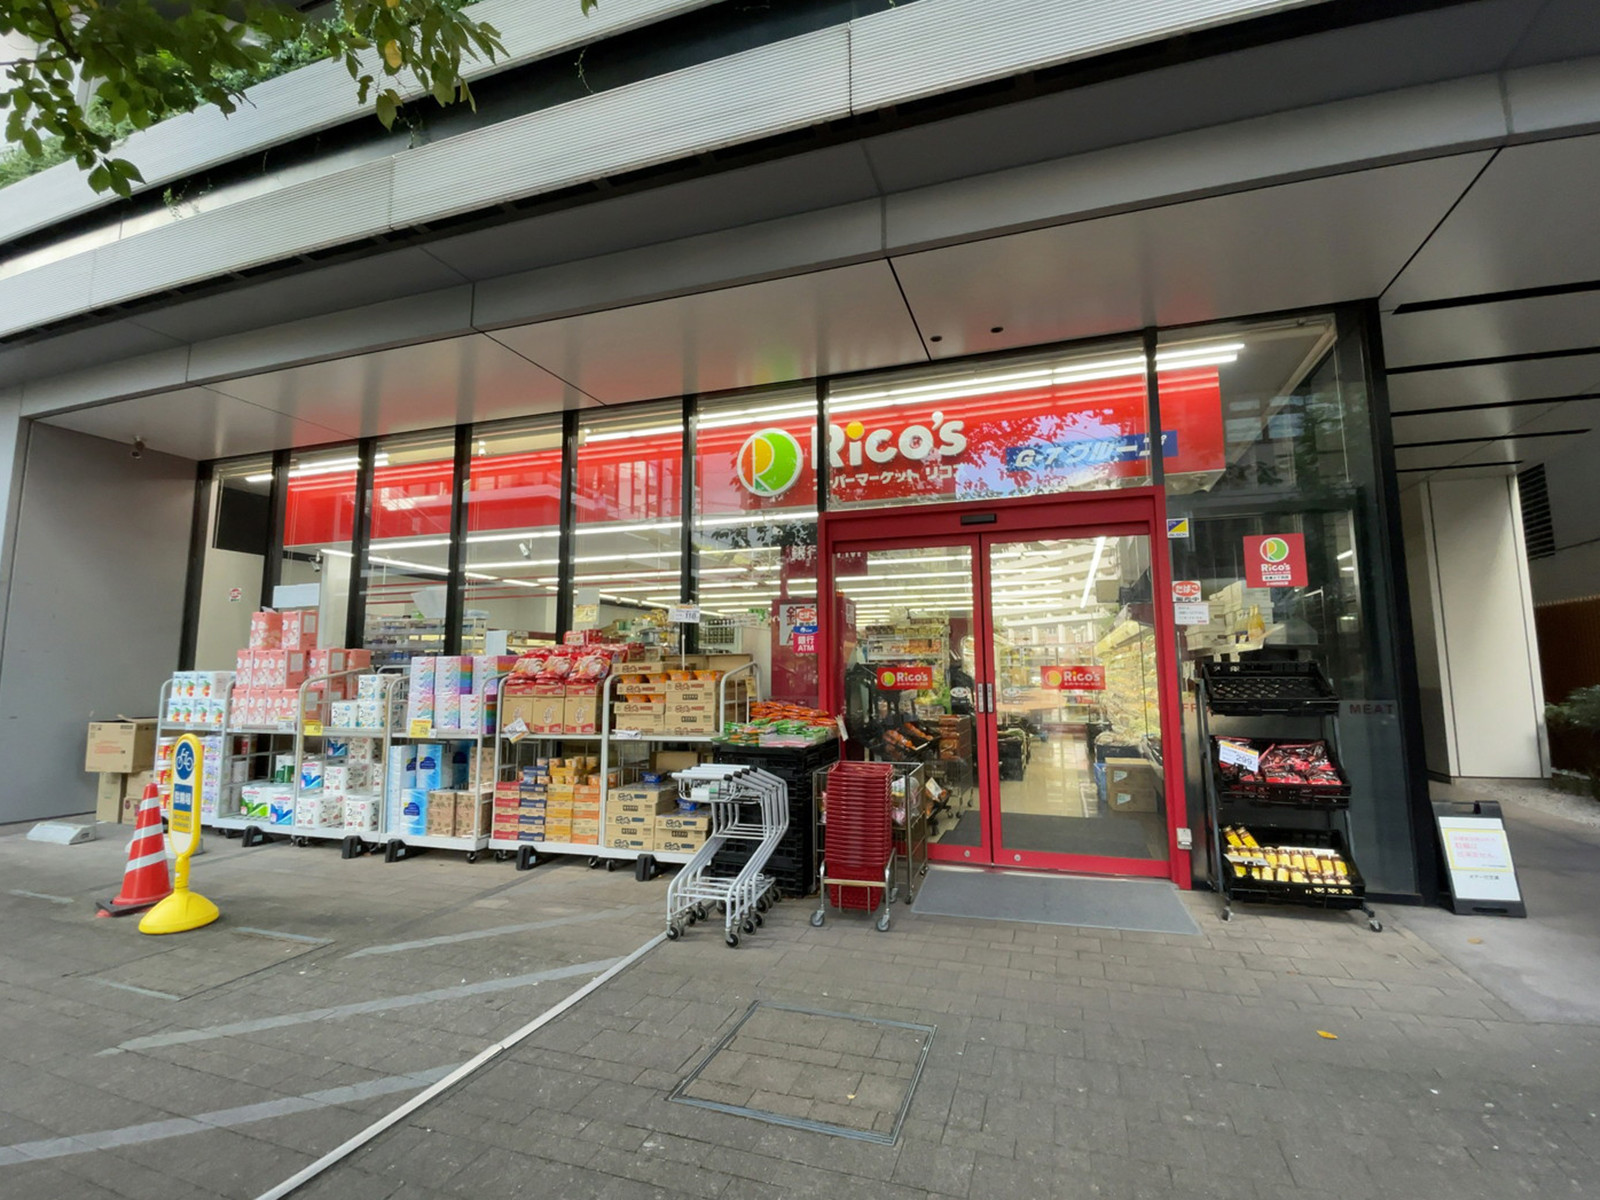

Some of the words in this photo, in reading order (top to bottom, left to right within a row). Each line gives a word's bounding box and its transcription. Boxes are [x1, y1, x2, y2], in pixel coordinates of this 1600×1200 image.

[811, 411, 967, 469] Rico's
[1261, 563, 1291, 572] Rico's
[896, 671, 928, 682] Rico's
[1063, 671, 1100, 682] Rico's
[1350, 704, 1393, 714] MEAT
